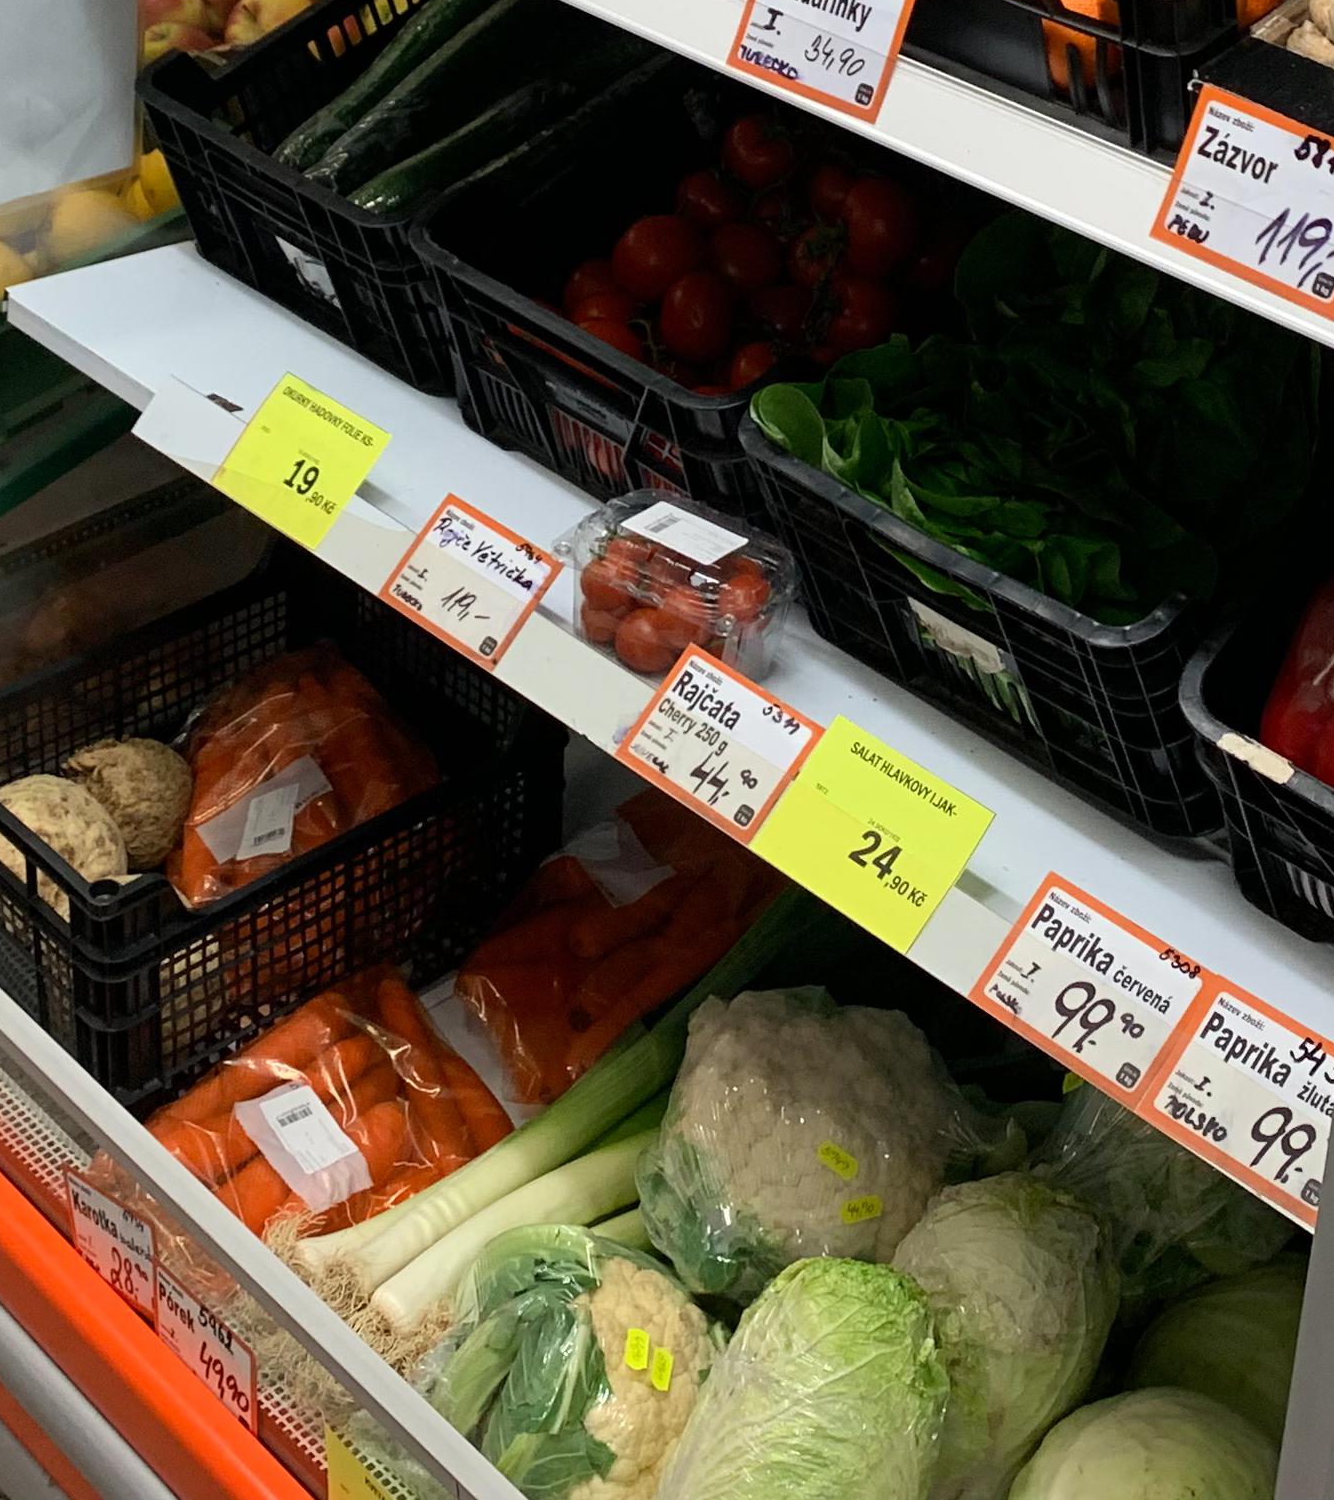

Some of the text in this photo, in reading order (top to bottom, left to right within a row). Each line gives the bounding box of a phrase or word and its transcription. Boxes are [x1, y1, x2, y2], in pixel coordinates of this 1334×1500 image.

[763, 7, 784, 36] I.
[804, 35, 865, 76] 34,90
[1197, 124, 1279, 184] Zázvor
[283, 459, 337, 515] 19,90 Kč
[658, 698, 698, 735] Cherry
[695, 722, 720, 747] 250
[715, 741, 729, 756] g
[672, 670, 741, 731] Rajčata
[850, 741, 883, 768] SALAT
[879, 761, 933, 802] HLAVKOVY
[848, 830, 928, 908] 24,90 Kč
[1031, 903, 1115, 976] Paprika
[1113, 965, 1173, 1015] červená
[1120, 1012, 1145, 1039] 90
[1200, 1011, 1292, 1088] Paprika
[1194, 1076, 1213, 1098] I.
[1164, 1094, 1228, 1143] POLSKO
[72, 1188, 118, 1239] Karotka
[159, 1281, 195, 1334] Pórek
[199, 1341, 249, 1412] 49,90
